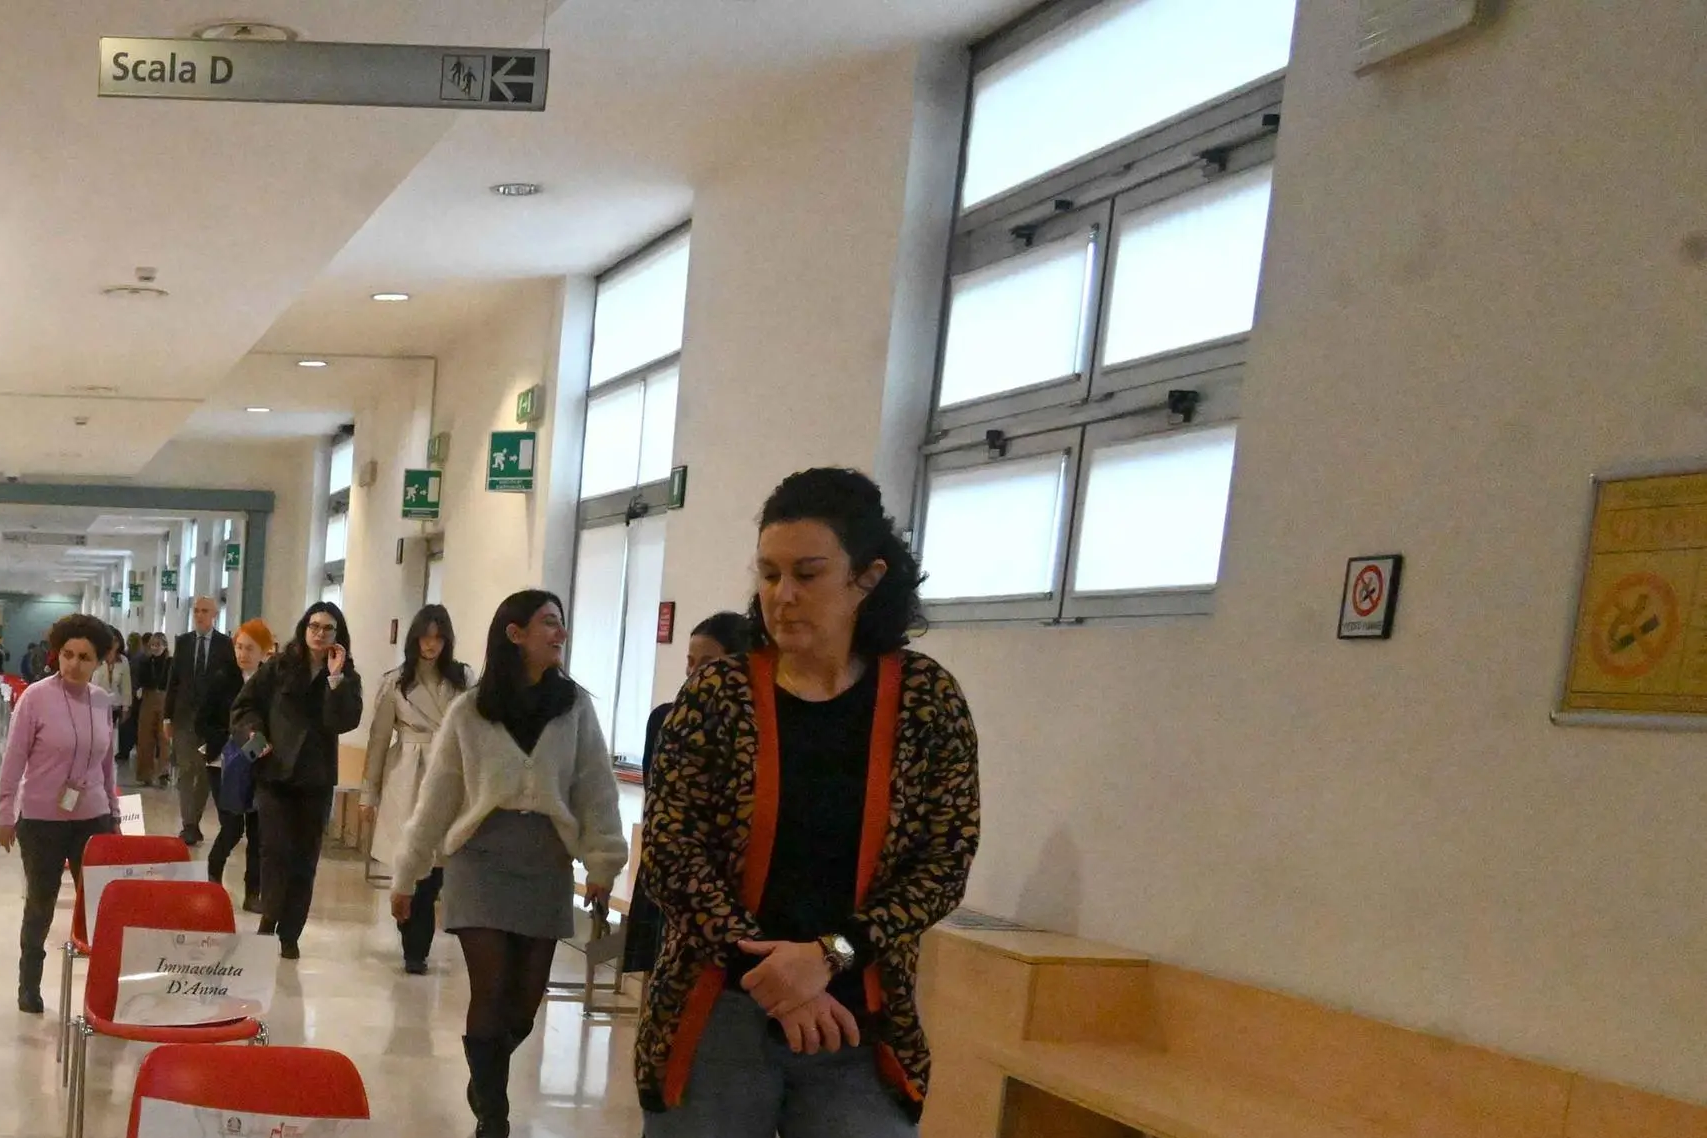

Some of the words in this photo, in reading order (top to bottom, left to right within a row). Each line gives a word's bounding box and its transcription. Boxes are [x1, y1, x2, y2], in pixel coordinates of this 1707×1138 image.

[111, 51, 197, 84] Scala
[210, 55, 234, 85] D
[156, 957, 244, 977] Immacolata
[166, 979, 229, 997] D'Anna
